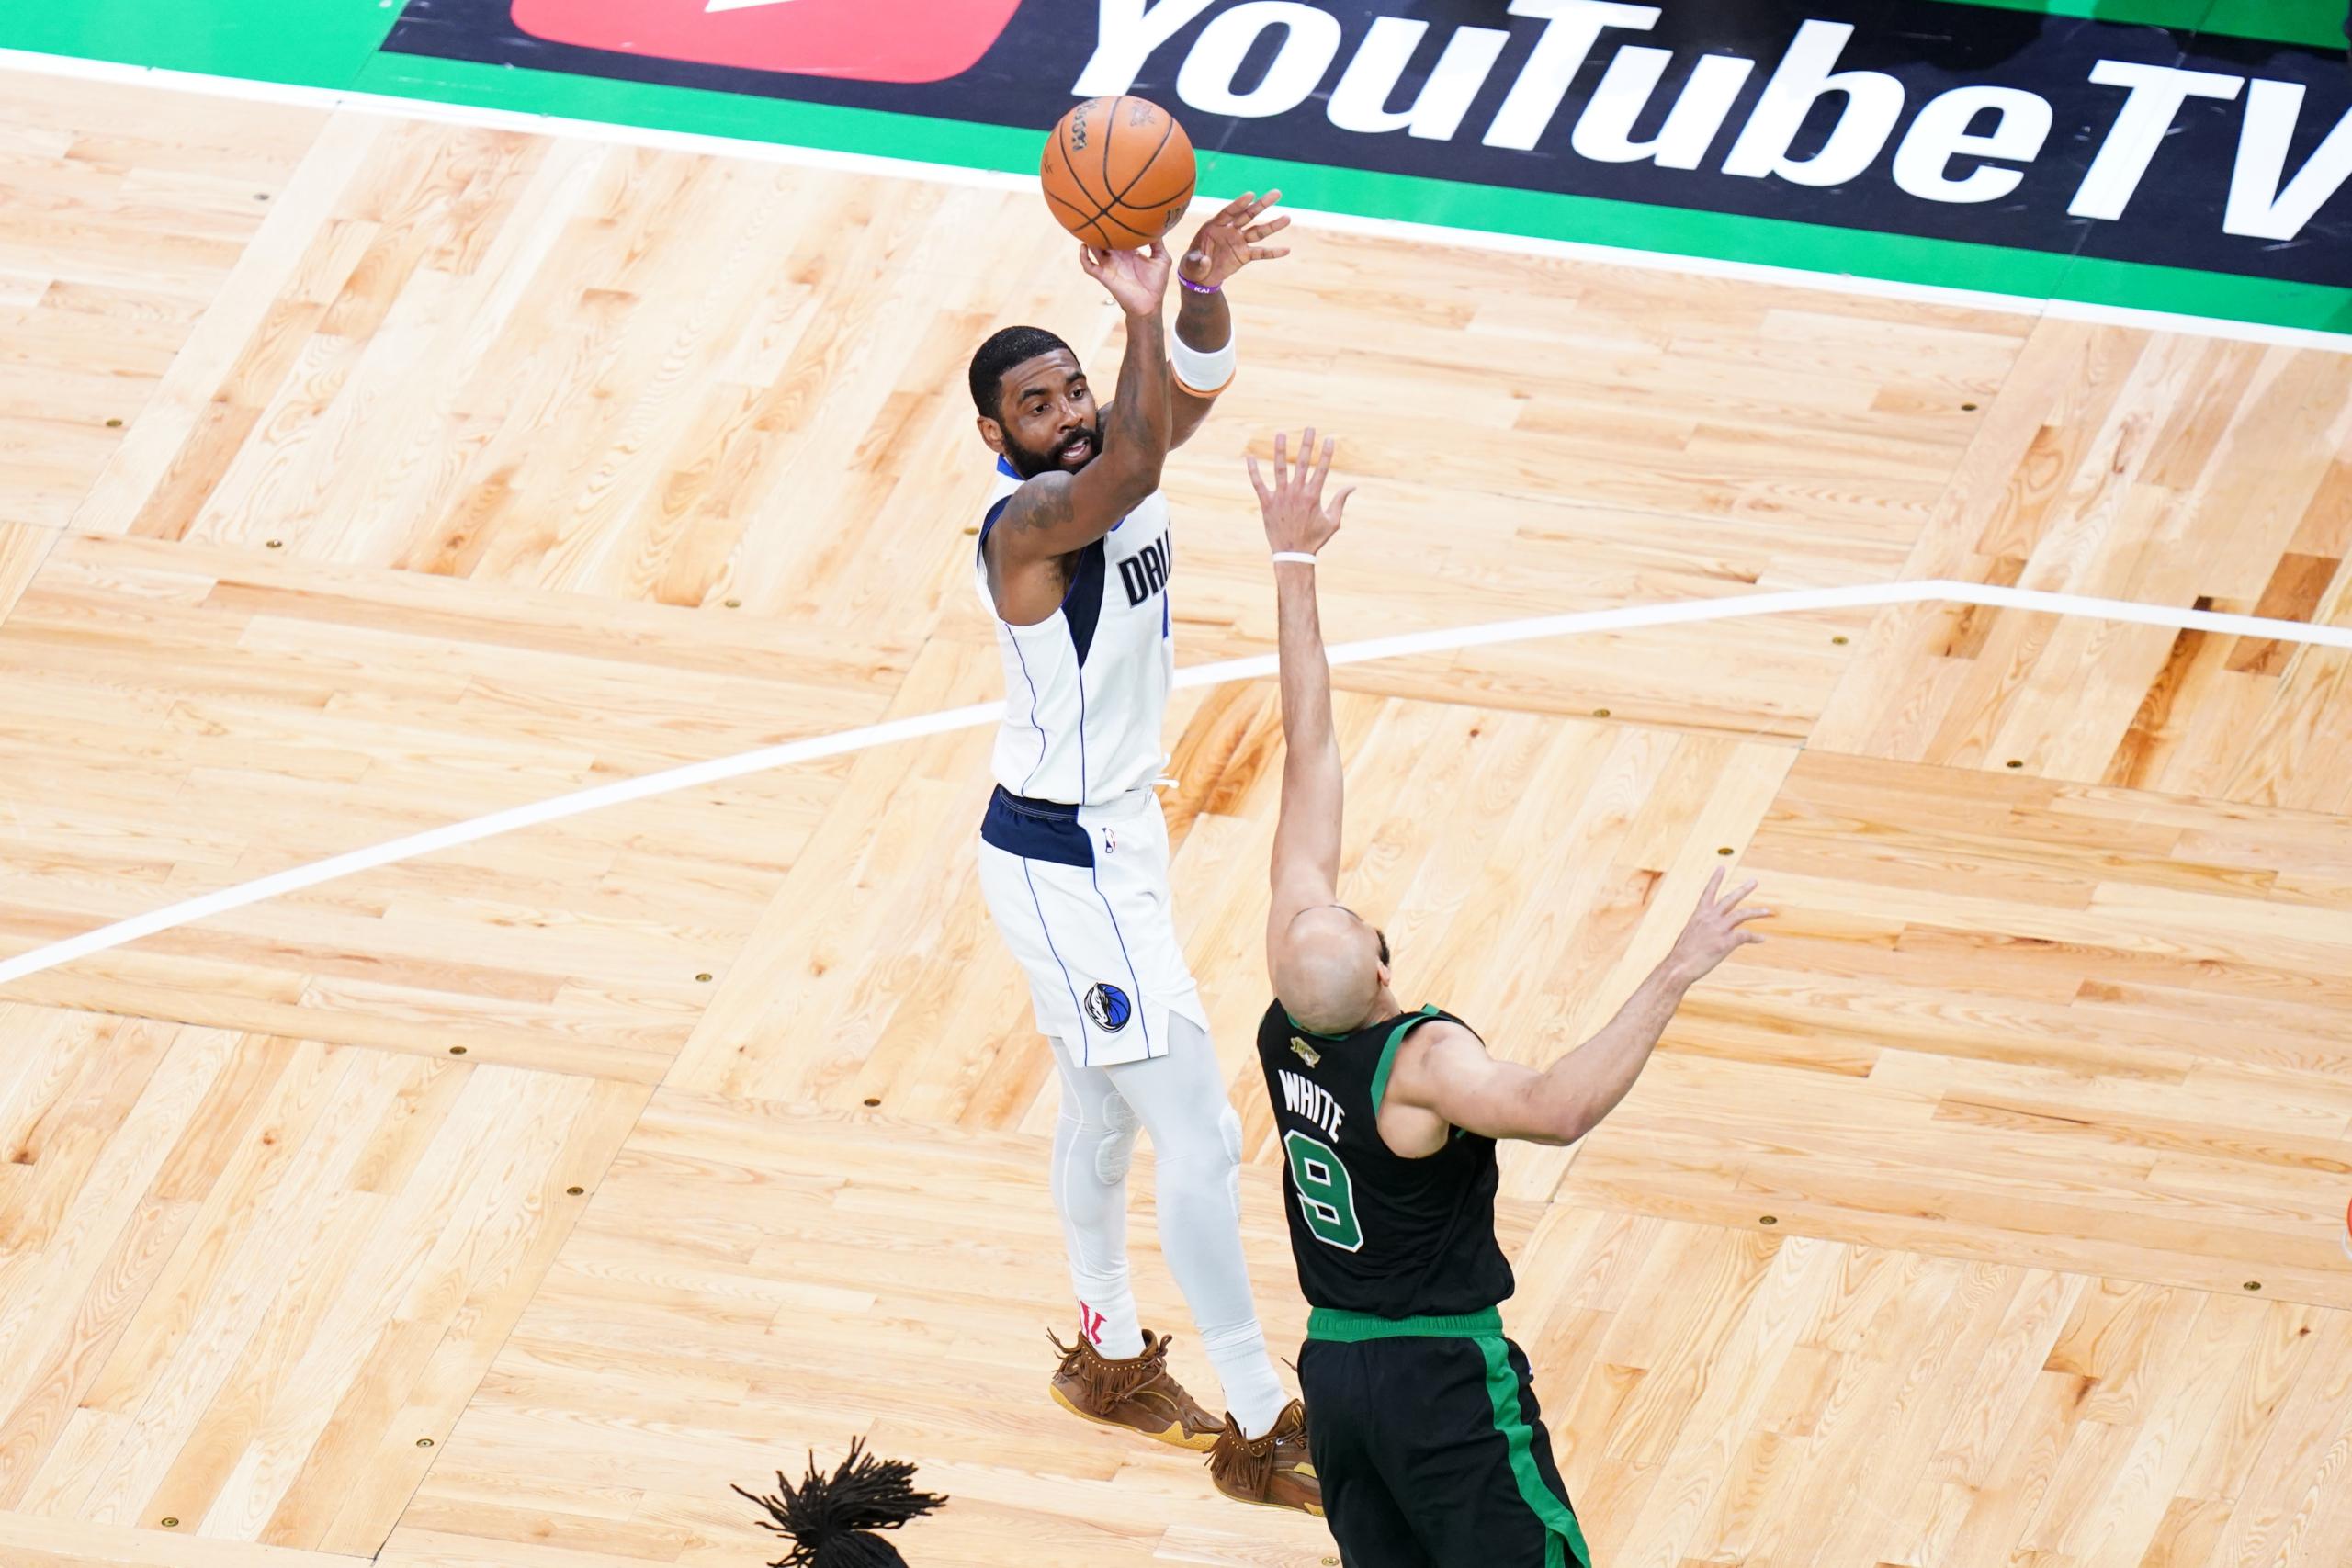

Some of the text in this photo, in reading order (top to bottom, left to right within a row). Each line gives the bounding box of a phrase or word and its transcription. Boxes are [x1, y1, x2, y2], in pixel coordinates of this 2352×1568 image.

[1071, 0, 2352, 242] YouTube TV
[1278, 1069, 1345, 1143] WHITE
[1283, 1129, 1364, 1253] 9
